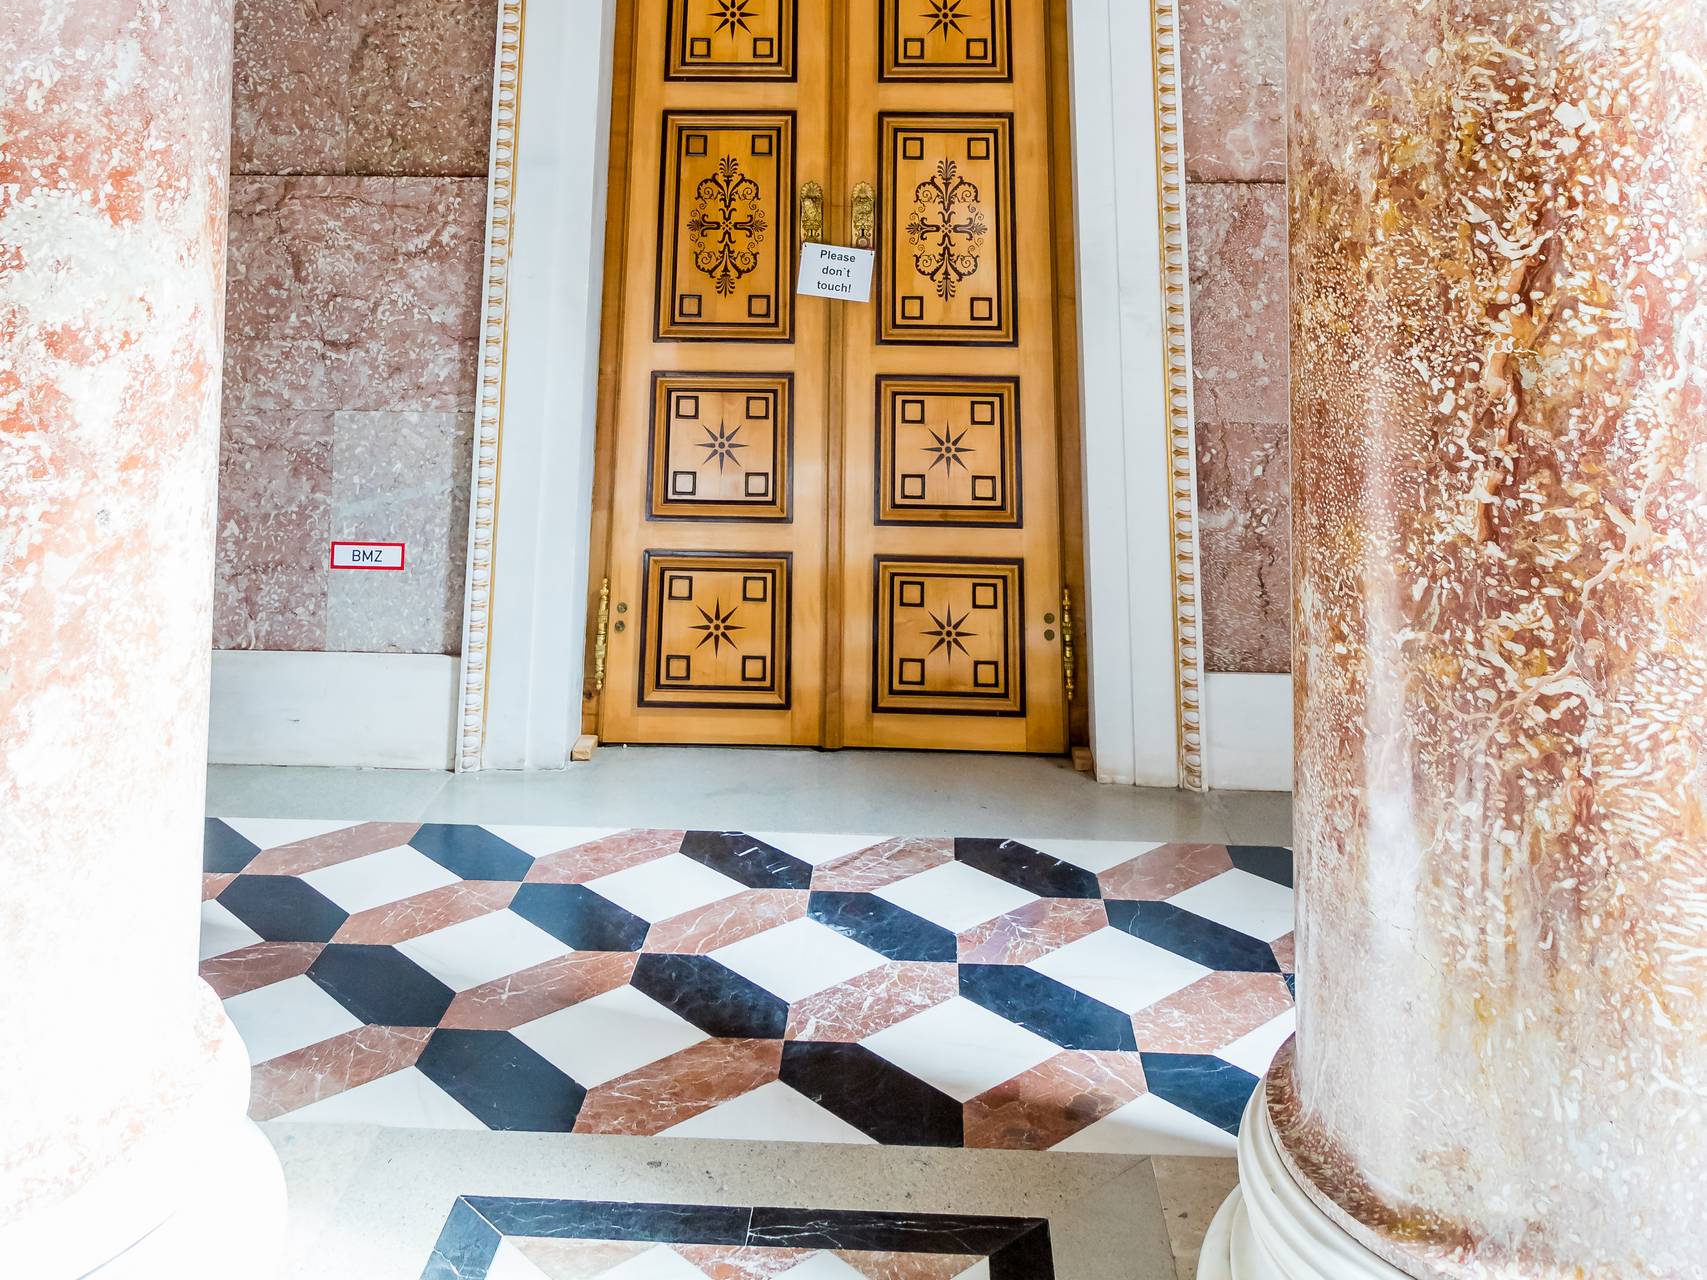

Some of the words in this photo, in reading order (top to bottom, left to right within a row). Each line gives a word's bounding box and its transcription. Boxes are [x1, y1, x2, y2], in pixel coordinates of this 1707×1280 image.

[820, 249, 856, 262] Please
[816, 281, 852, 293] touch!
[352, 549, 383, 562] BMZ
